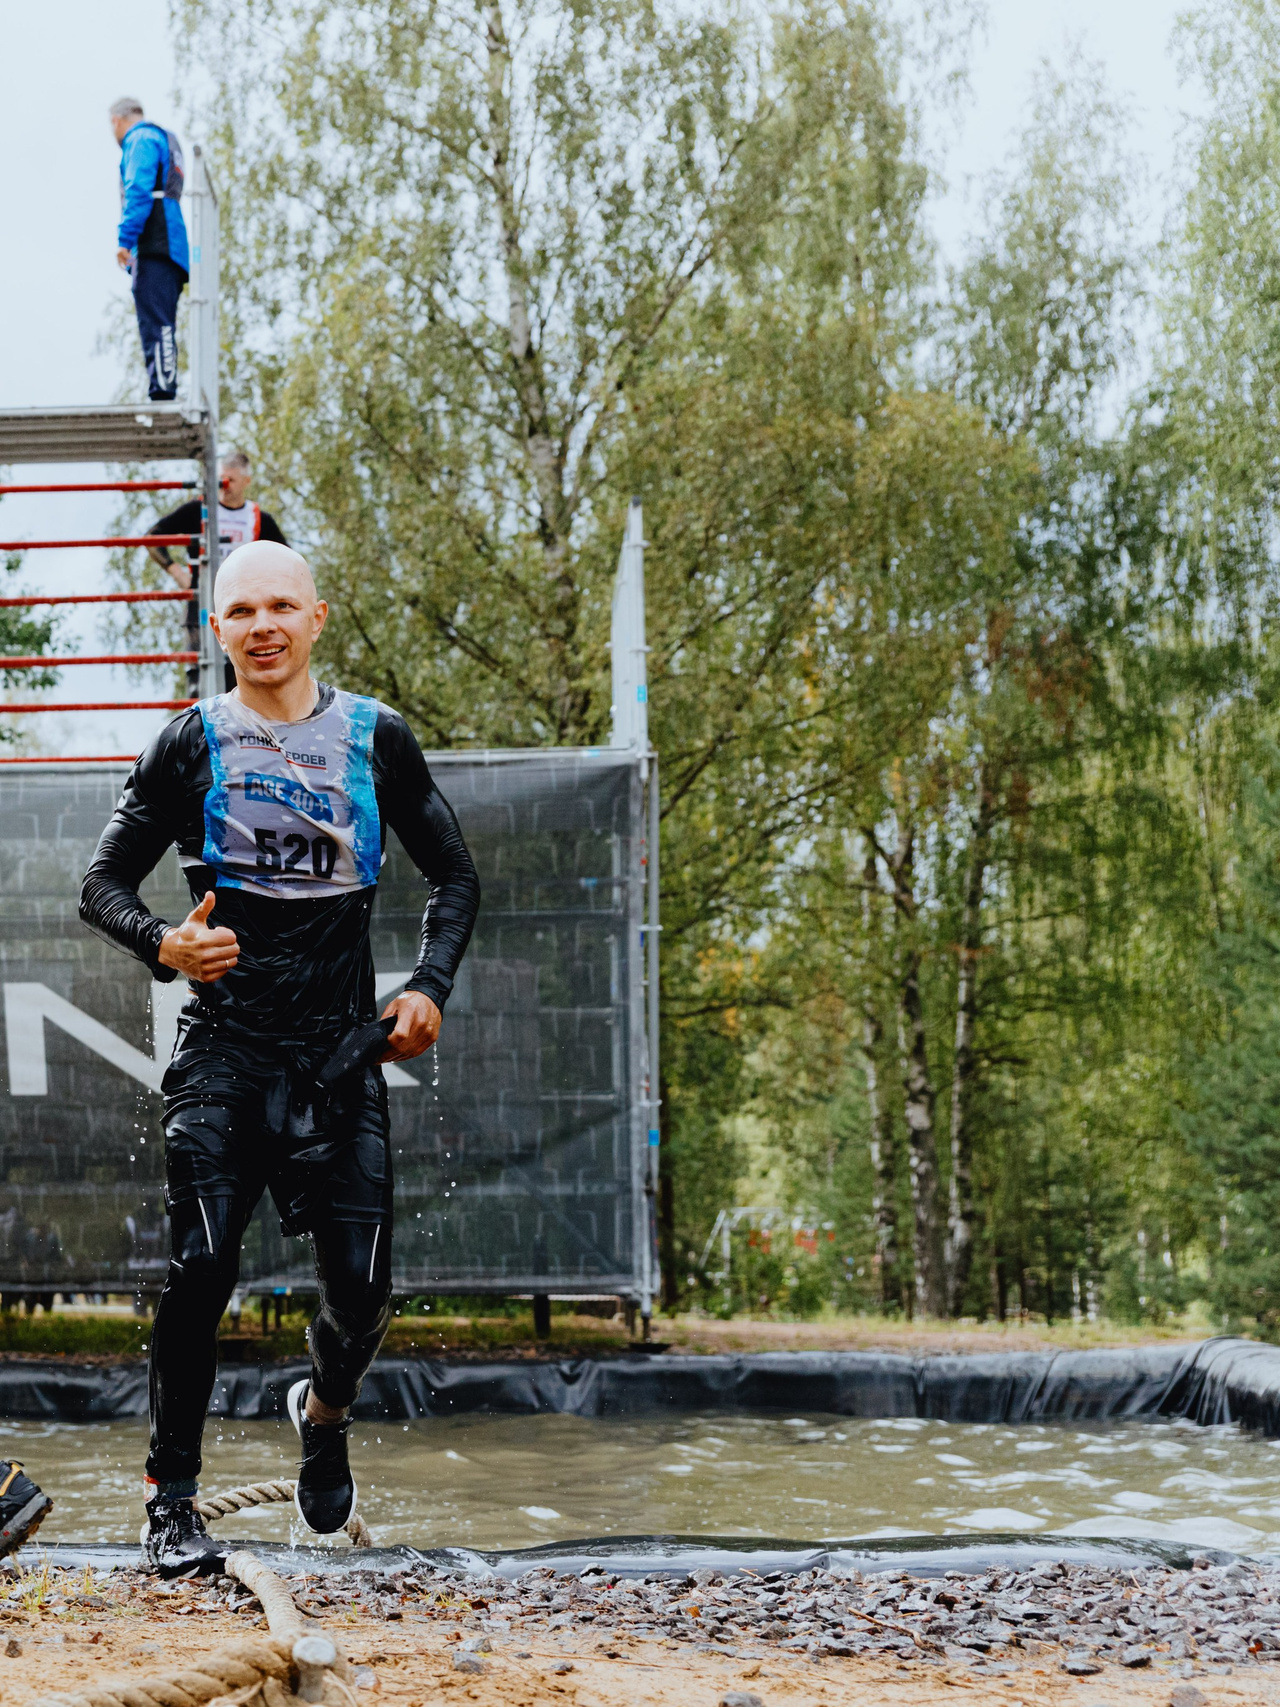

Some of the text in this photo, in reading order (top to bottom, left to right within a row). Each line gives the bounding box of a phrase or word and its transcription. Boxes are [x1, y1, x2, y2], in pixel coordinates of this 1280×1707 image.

[239, 735, 327, 766] ГОНК ЕРОЕВ
[250, 778, 330, 813] AGE 40+
[254, 828, 337, 879] 520
